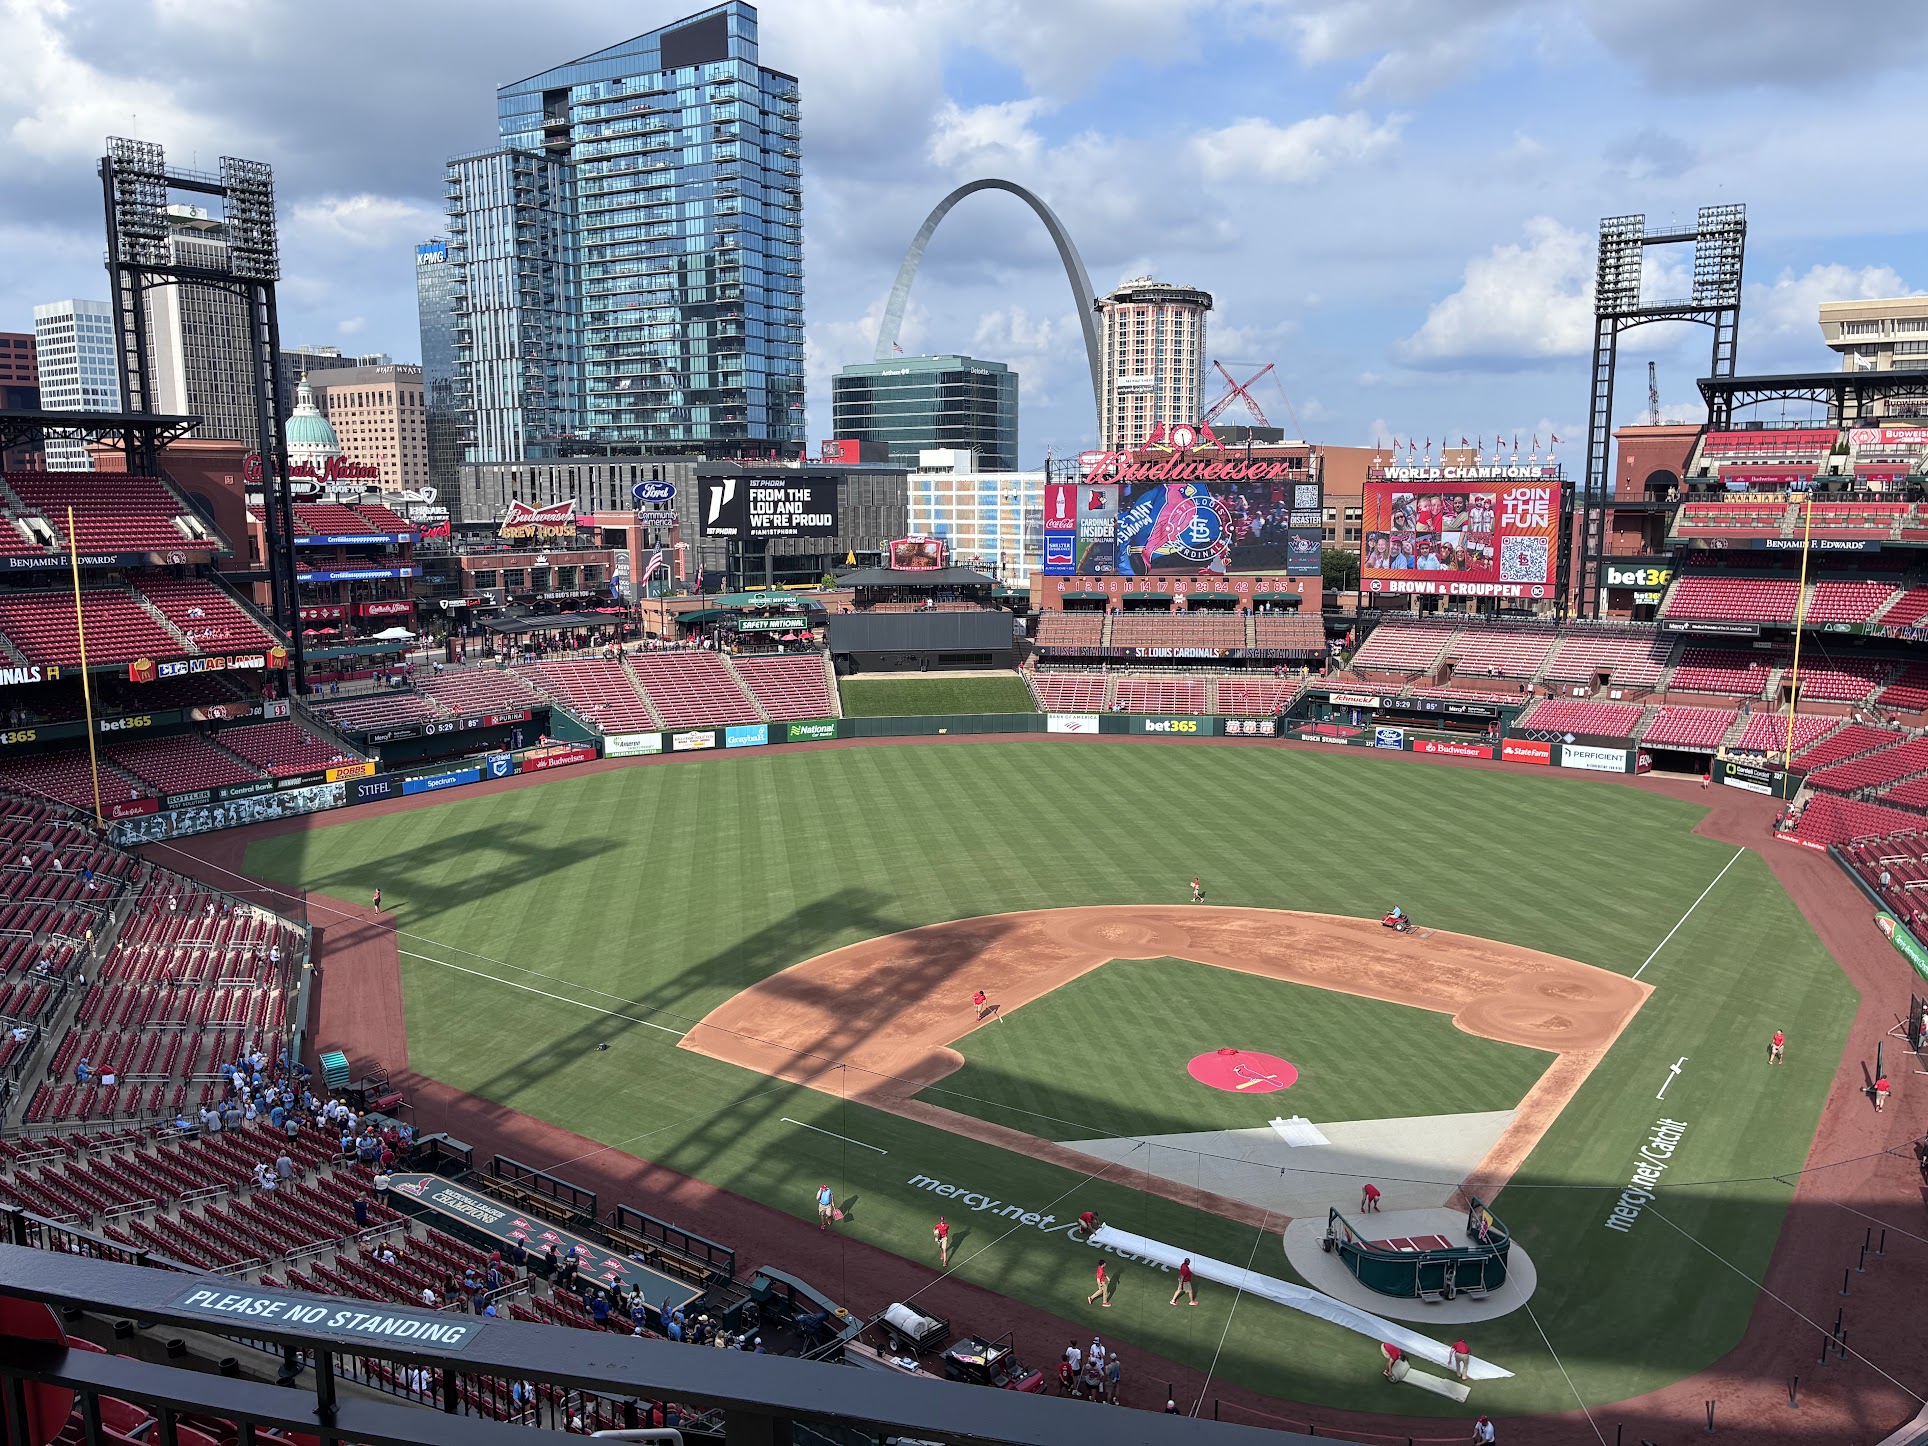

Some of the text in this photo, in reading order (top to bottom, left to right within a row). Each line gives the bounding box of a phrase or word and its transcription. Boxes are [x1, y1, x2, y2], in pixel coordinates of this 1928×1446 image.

[417, 250, 445, 265] KPMG
[376, 366, 393, 374] HYATT
[396, 366, 421, 374] HYATT
[318, 456, 378, 482] Nation
[1079, 450, 1291, 484] Budweiser
[1384, 466, 1542, 479] WORLD CHAMPIONS
[642, 483, 668, 499] Ford
[749, 488, 811, 501] FROM THE
[1502, 488, 1550, 501] JOIN
[750, 501, 802, 514] LOU AND
[1196, 499, 1225, 516] LOUIS
[1503, 501, 1549, 514] THE
[637, 511, 677, 521] Community
[750, 514, 832, 527] WE'RE PROUD
[1081, 518, 1114, 526] CARDINALS
[1502, 514, 1548, 528] FUN
[502, 525, 576, 538] BREW HOUSE
[1081, 527, 1114, 537] INSIDER
[1811, 540, 1864, 549] F. EDWARDS
[10, 557, 68, 568] BENJAMIN F.
[1085, 582, 1092, 592] 2
[1097, 582, 1104, 592] 6
[1110, 582, 1117, 592] 9
[1123, 582, 1133, 592] 10
[1140, 582, 1151, 592] 14
[1157, 582, 1168, 592] 17
[1174, 582, 1187, 592] 20
[1215, 582, 1228, 592] 24
[1235, 582, 1248, 592] 42
[1255, 582, 1269, 592] 45
[1274, 582, 1287, 592] 85
[1390, 581, 1520, 597] BROWN & CROUPPEN
[742, 619, 804, 629] SAFETY NATIONAL
[1135, 648, 1219, 658] ST. LOUIS CARDINALS
[158, 654, 265, 678] BIG MAC LAND
[1333, 694, 1375, 703] Schnucks
[1395, 700, 1410, 708] 5:29
[499, 713, 523, 722] PURINA
[100, 716, 152, 732] bet365
[438, 722, 453, 732] 5:29
[800, 723, 834, 735] National
[1146, 719, 1196, 732] bet365
[374, 731, 390, 741] Mercy
[1302, 734, 1347, 745] BUSCH STADIUM
[1437, 745, 1480, 756] Budweiser
[1574, 751, 1624, 762] PERFICIENT
[488, 754, 511, 762] CarShield
[548, 754, 584, 766] Budweiser
[336, 765, 366, 776] DOBBS
[1737, 766, 1753, 774] Cordell
[1754, 770, 1770, 778] Cordell
[428, 776, 456, 787] Spectrum
[230, 782, 273, 795] Central Bank
[358, 782, 391, 797] STIFEL
[169, 791, 209, 804] ROTTLER
[182, 799, 209, 808] SOLUTIONS
[442, 1189, 478, 1206] NATIONAL
[432, 1192, 498, 1224] CHAMPIONS
[185, 1290, 466, 1344] PLEASE NO STANDING
